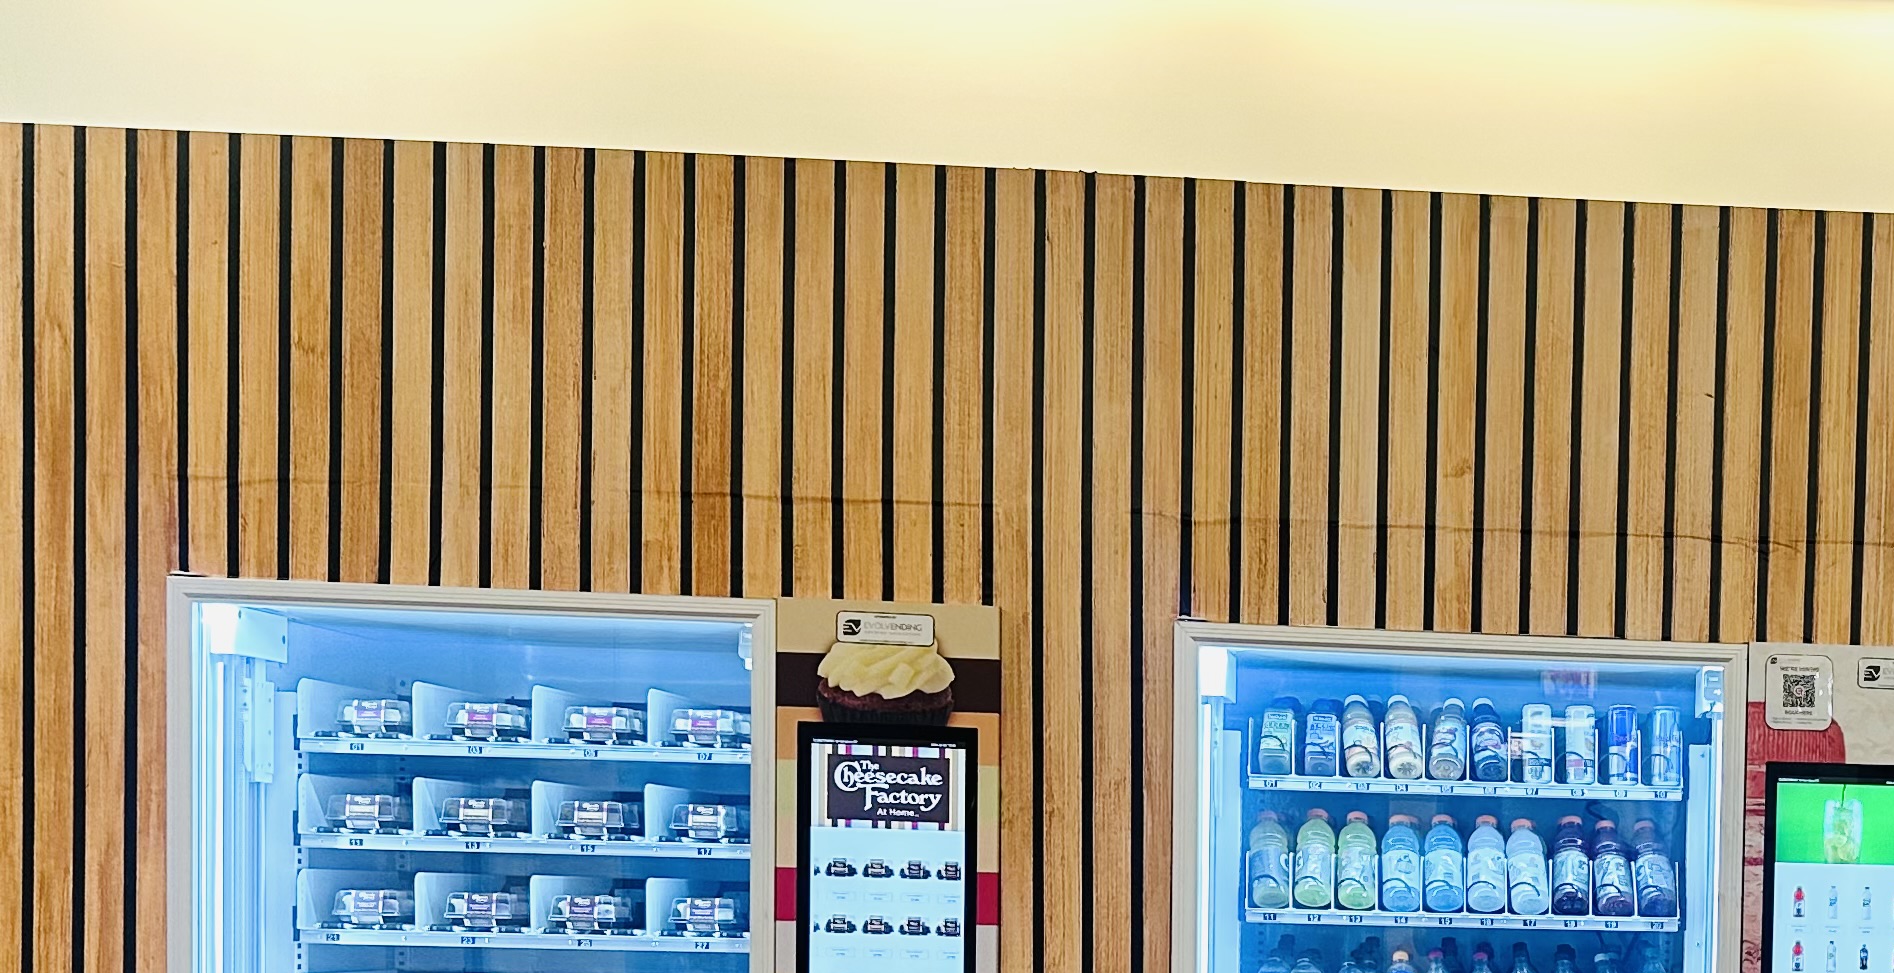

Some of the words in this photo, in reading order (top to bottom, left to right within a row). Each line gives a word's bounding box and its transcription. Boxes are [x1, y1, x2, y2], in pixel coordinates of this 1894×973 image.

[860, 760, 879, 770] The
[834, 761, 943, 792] Cheesecake
[856, 783, 942, 812] Factory
[877, 808, 887, 816] At
[351, 838, 361, 846] 11
[1309, 914, 1319, 922] 12
[1396, 916, 1406, 924] 14
